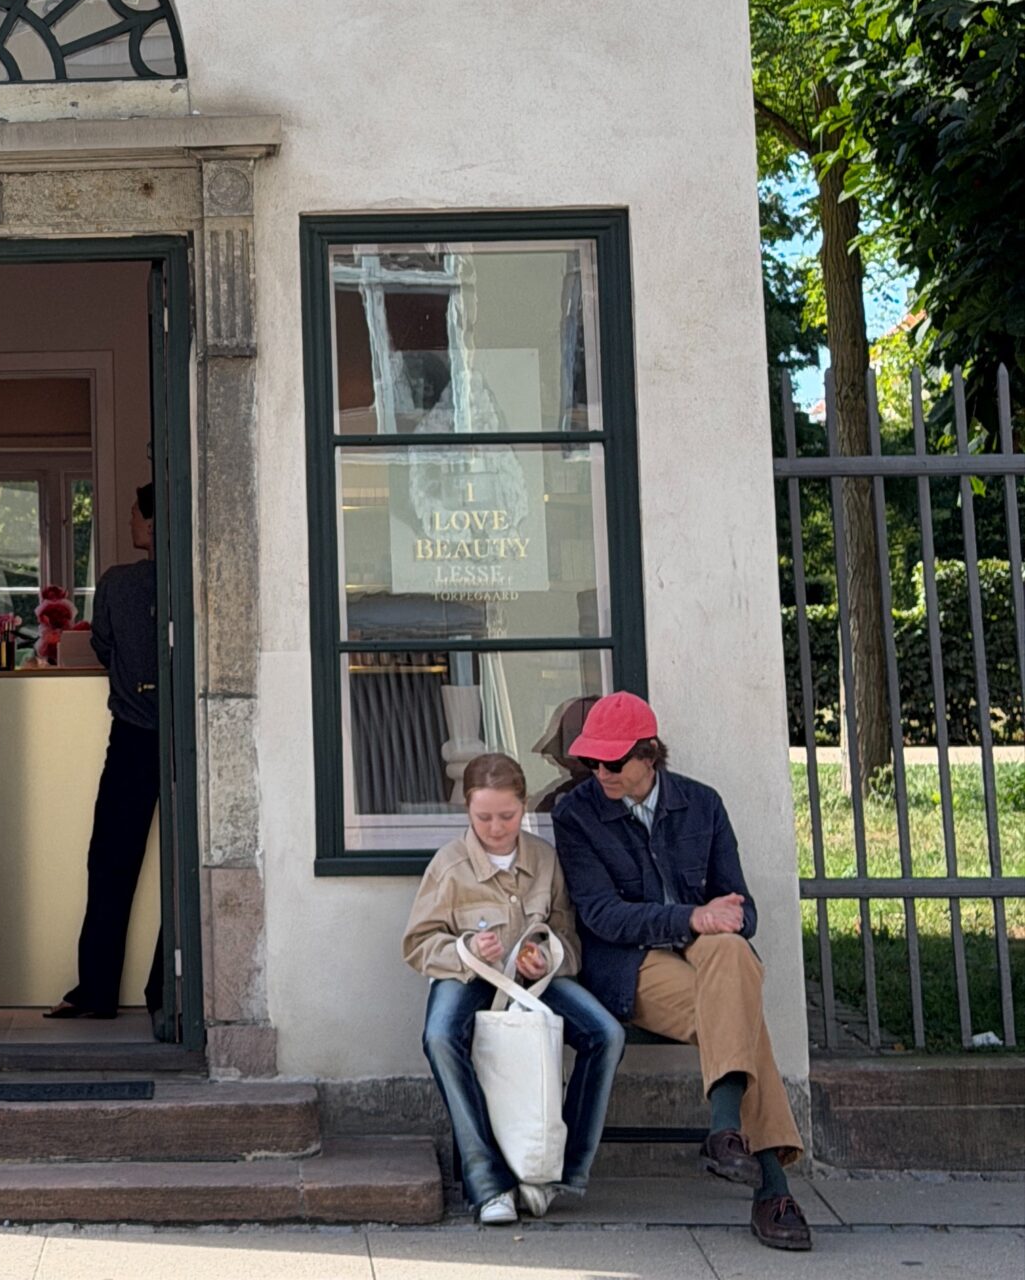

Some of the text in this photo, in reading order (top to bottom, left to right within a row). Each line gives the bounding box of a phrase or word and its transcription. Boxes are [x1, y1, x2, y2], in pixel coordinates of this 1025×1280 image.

[466, 480, 475, 502] I
[433, 510, 509, 530] LOVE
[415, 538, 530, 559] BEAUTY
[436, 565, 502, 582] LESSE
